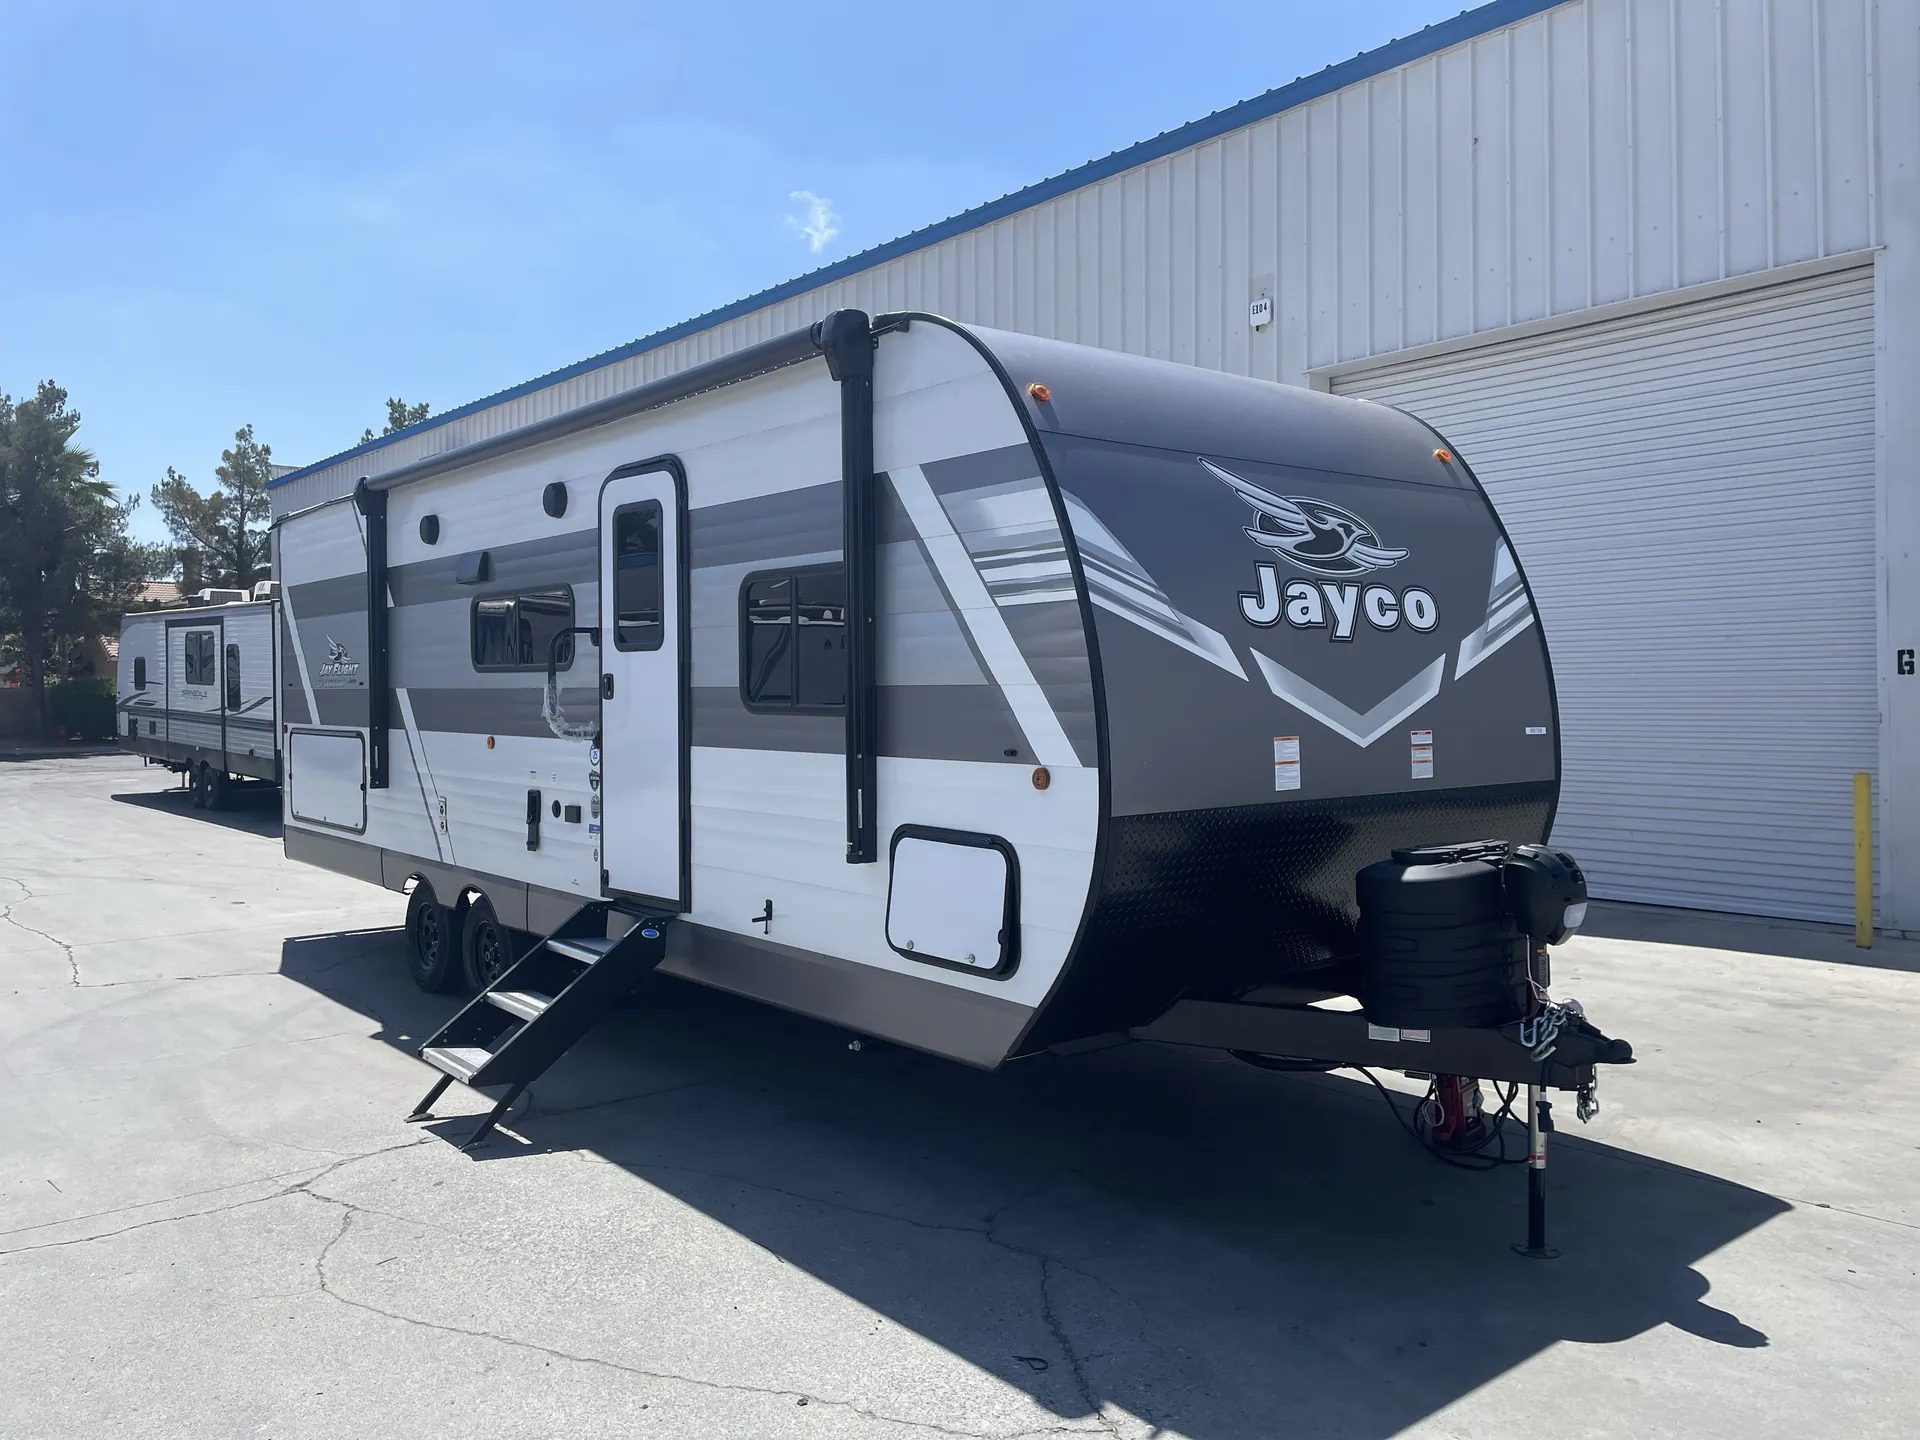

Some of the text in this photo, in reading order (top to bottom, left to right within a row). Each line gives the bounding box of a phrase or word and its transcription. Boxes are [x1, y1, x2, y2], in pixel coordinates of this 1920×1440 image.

[1252, 302, 1268, 315] E104
[1238, 561, 1440, 642] Jayco
[319, 662, 360, 677] JAY FLIGHT
[1897, 648, 1915, 675] G
